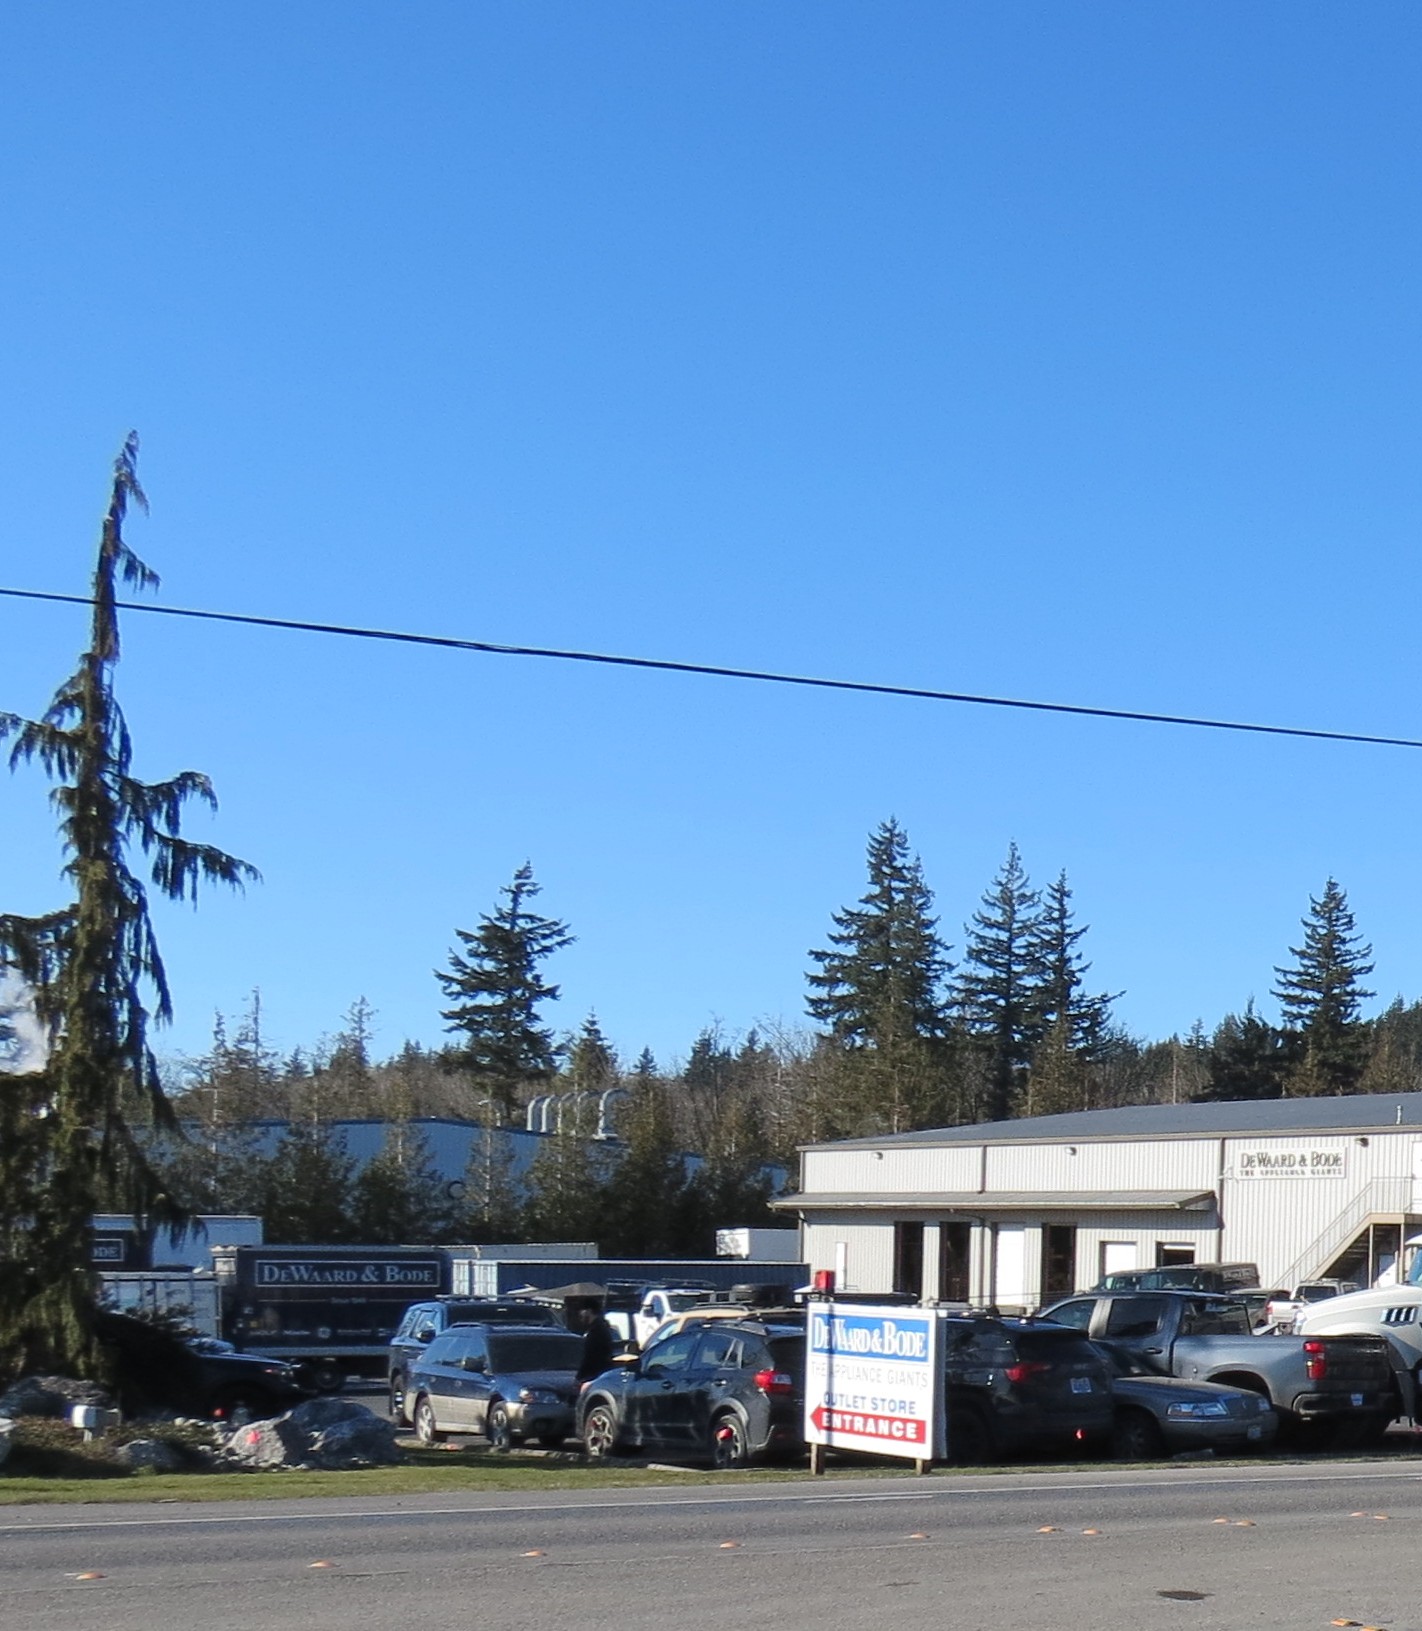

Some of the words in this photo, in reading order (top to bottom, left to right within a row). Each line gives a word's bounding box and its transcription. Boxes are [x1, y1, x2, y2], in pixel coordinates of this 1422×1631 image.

[1299, 1154, 1308, 1168] &
[263, 1264, 358, 1283] DEWAARD
[361, 1264, 379, 1283] &
[385, 1264, 433, 1283] BODE
[871, 1328, 882, 1353] &
[882, 1321, 926, 1358] BODE
[887, 1369, 928, 1388] GIANTS
[824, 1391, 867, 1410] OUTLET
[871, 1396, 916, 1415] STORE
[821, 1411, 917, 1439] ENTRANCE
